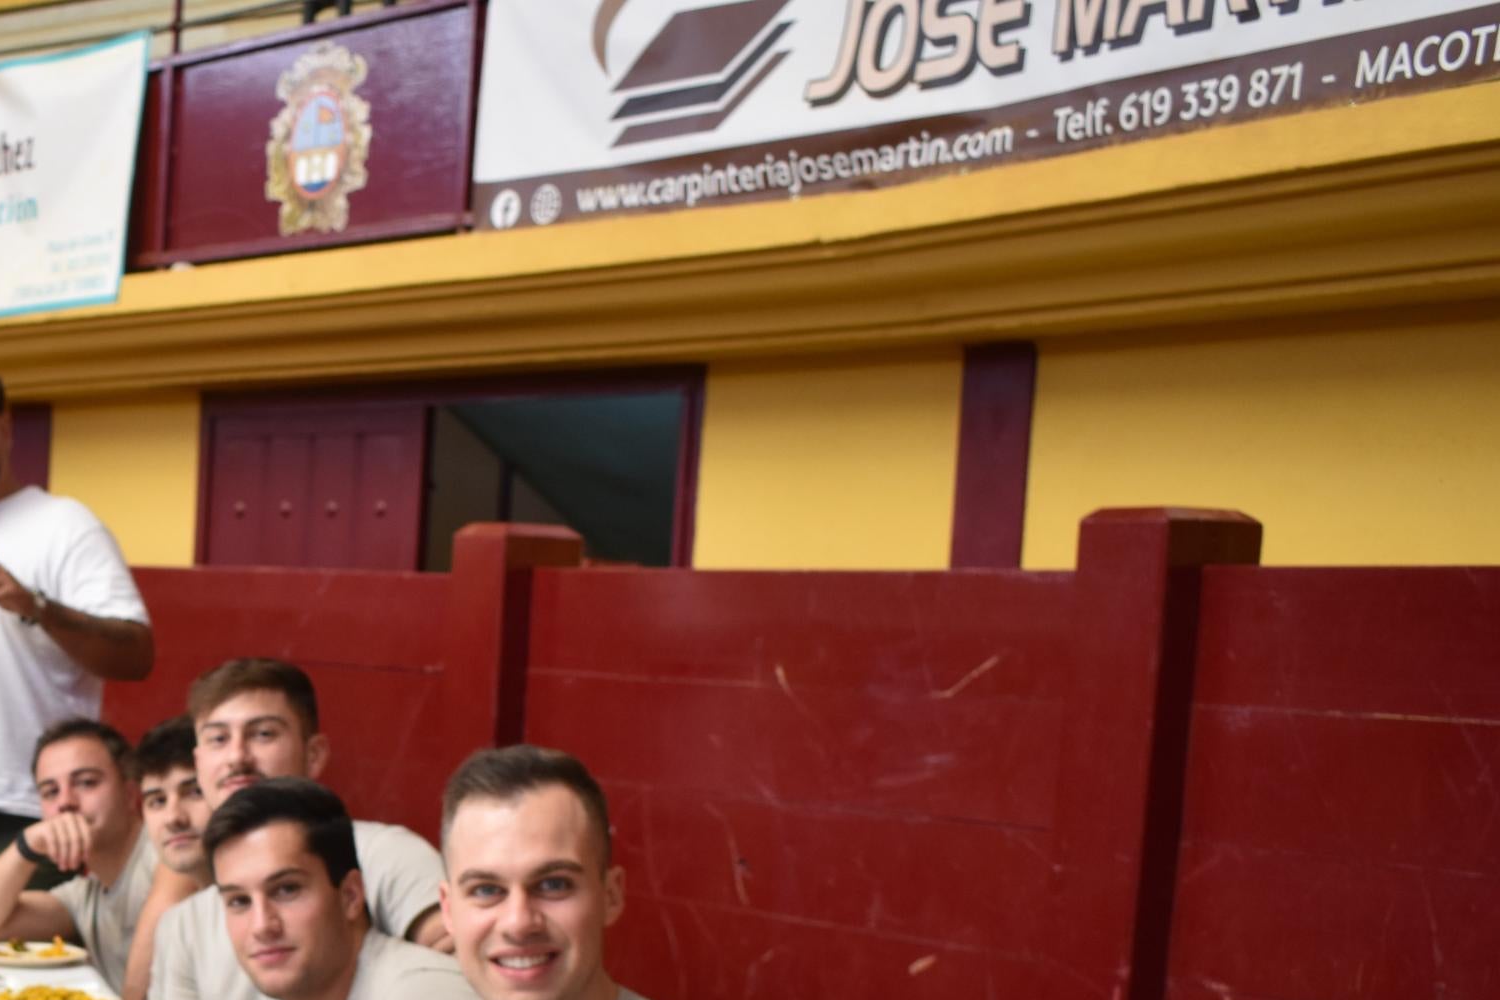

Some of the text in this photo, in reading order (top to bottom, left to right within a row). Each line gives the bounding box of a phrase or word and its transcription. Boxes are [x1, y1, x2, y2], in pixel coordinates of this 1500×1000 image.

[575, 124, 1014, 206] www.carpinteriajosemartin.com
[1053, 96, 1114, 144] Telf.
[1118, 86, 1172, 132] 619
[1179, 73, 1241, 121] 339
[1247, 61, 1304, 109] 871
[1354, 22, 1500, 89] MACOT
